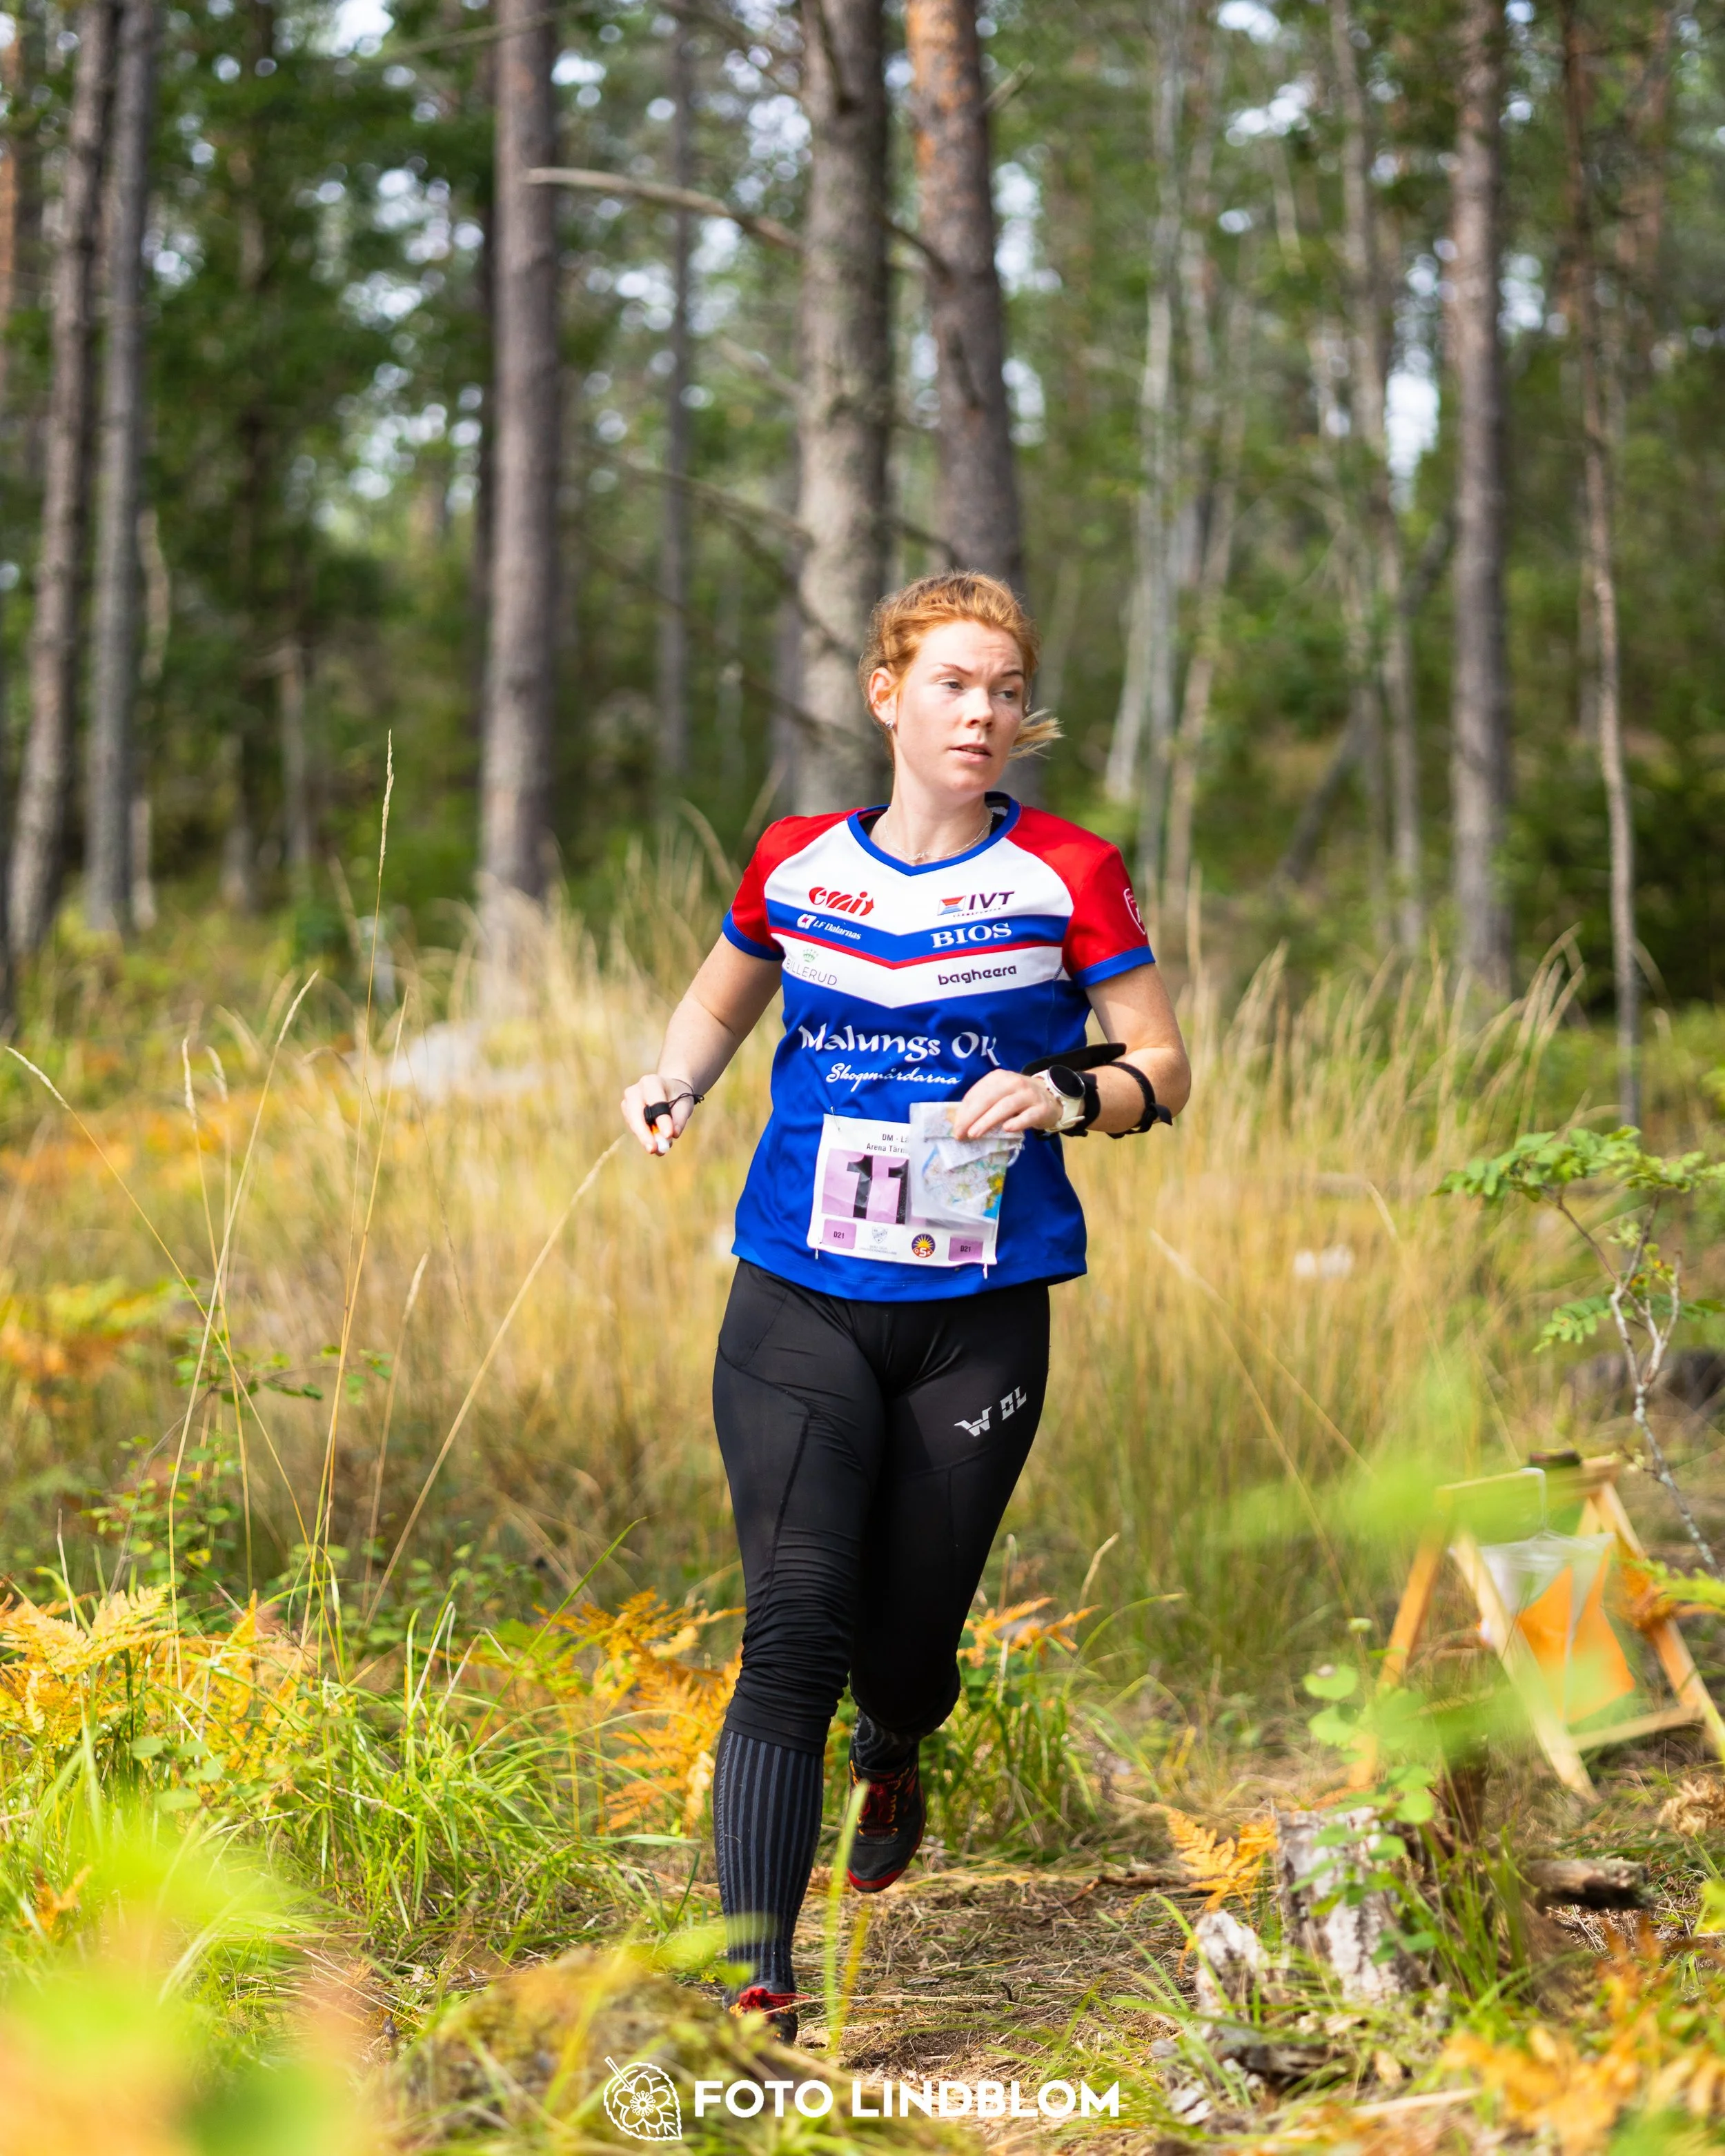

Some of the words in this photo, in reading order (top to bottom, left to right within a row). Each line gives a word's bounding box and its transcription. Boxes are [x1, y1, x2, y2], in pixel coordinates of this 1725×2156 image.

[968, 891, 1015, 910] IVT
[930, 922, 1012, 948] BIOS
[786, 958, 838, 986] BILLERUD
[938, 965, 1018, 985] bagheera
[798, 1022, 941, 1063] Malungs
[952, 1031, 1001, 1067] OK
[867, 1143, 887, 1151] Arena
[833, 1230, 845, 1239] D21
